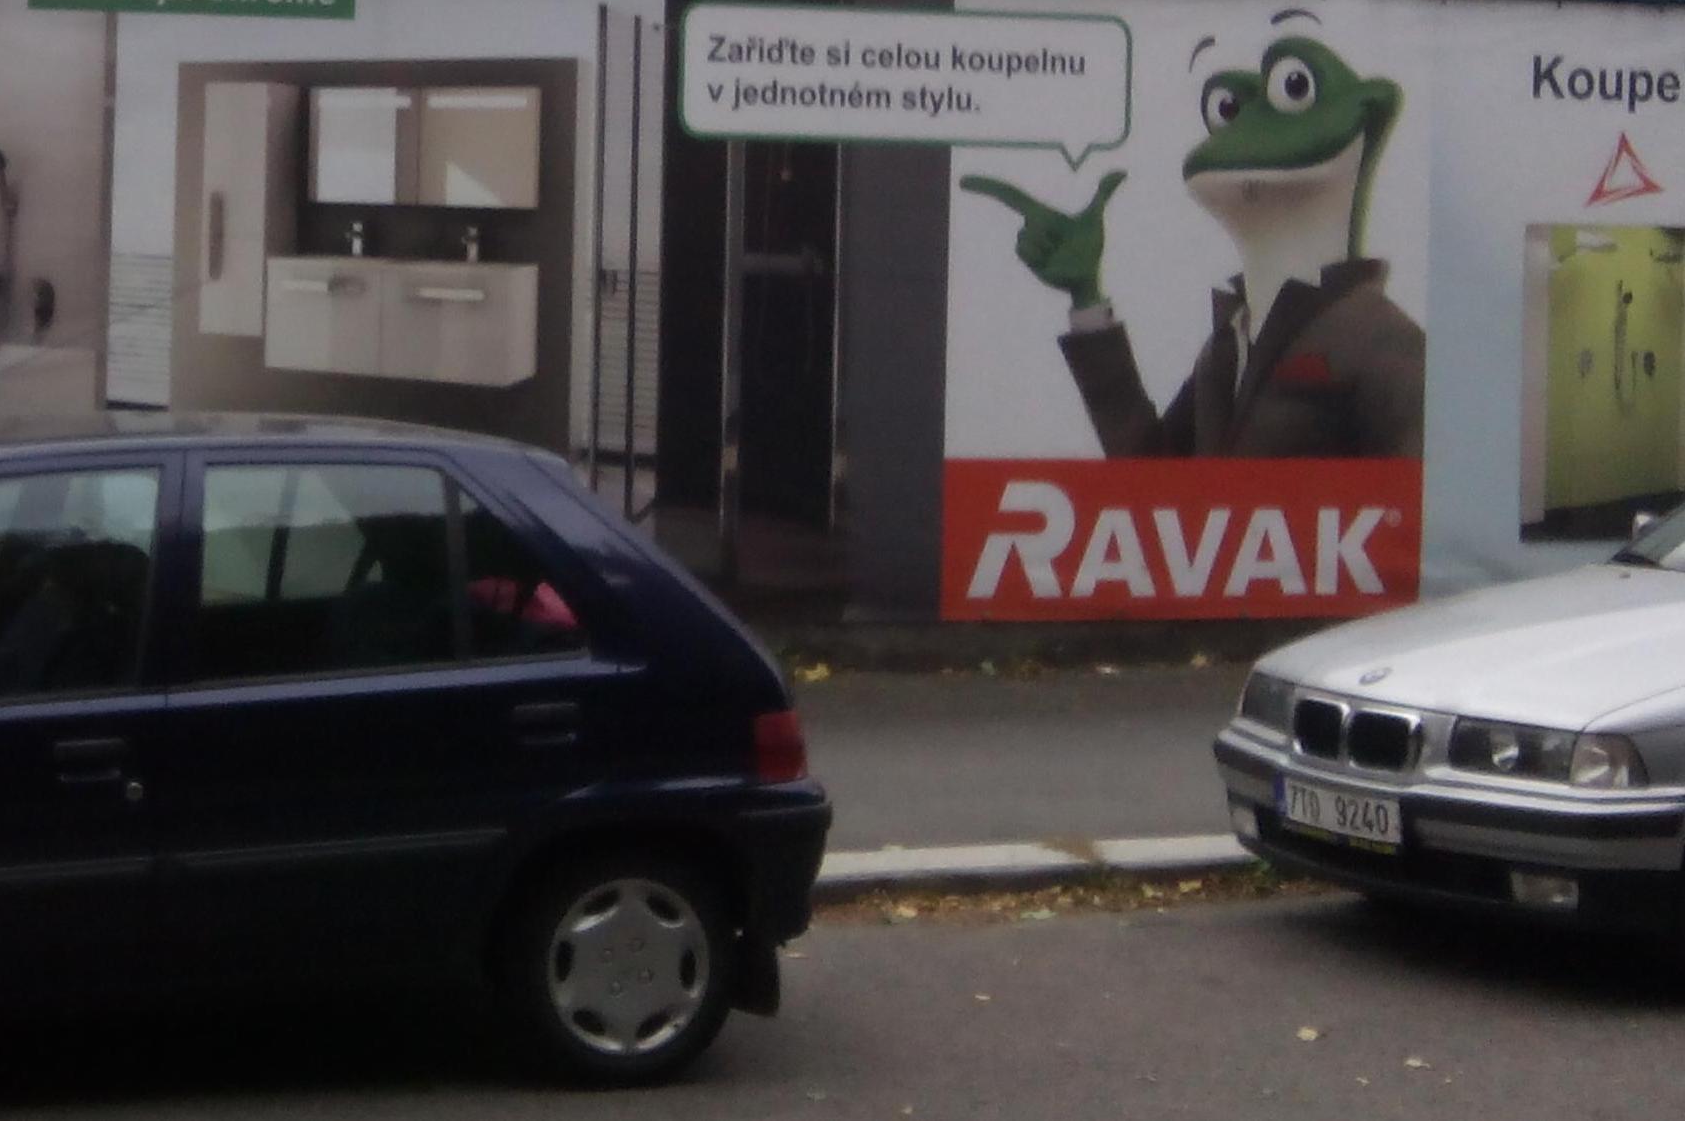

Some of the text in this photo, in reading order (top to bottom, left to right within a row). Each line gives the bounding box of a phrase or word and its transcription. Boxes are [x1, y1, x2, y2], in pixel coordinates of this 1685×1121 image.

[826, 39, 851, 67] si
[861, 42, 940, 70] celou
[951, 45, 1086, 78] koupelnu
[707, 79, 981, 117] v jednotném stylu.
[1532, 54, 1681, 113] Koupe
[966, 481, 1386, 599] RAVAK
[1334, 795, 1390, 835] 9240
